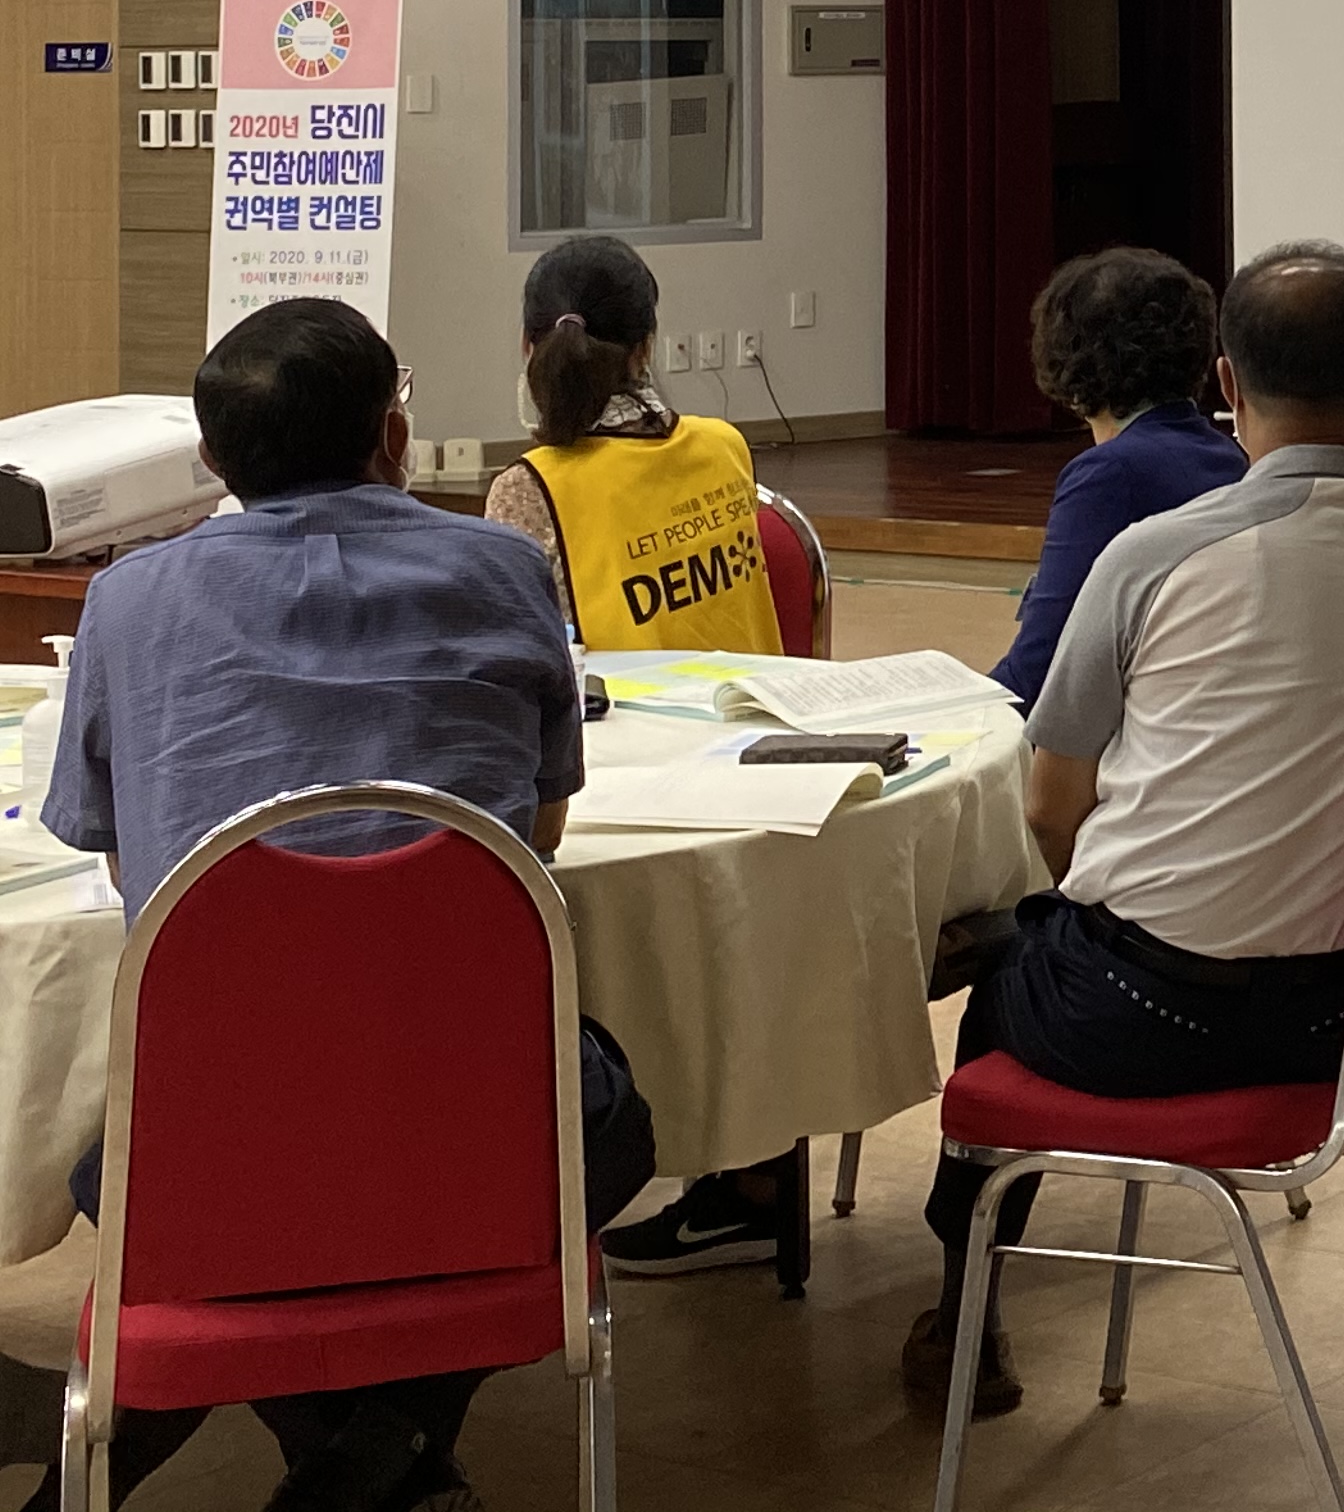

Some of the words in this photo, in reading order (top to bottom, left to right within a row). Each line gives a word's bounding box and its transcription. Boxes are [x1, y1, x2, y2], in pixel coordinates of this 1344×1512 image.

[229, 115, 299, 139] 2020년
[310, 103, 385, 140] 당진시
[227, 149, 384, 186] 주민참여예산제
[225, 195, 300, 231] 권역별
[309, 194, 382, 231] 컨설팅
[626, 532, 658, 560] LET
[663, 508, 725, 547] PEOPLE
